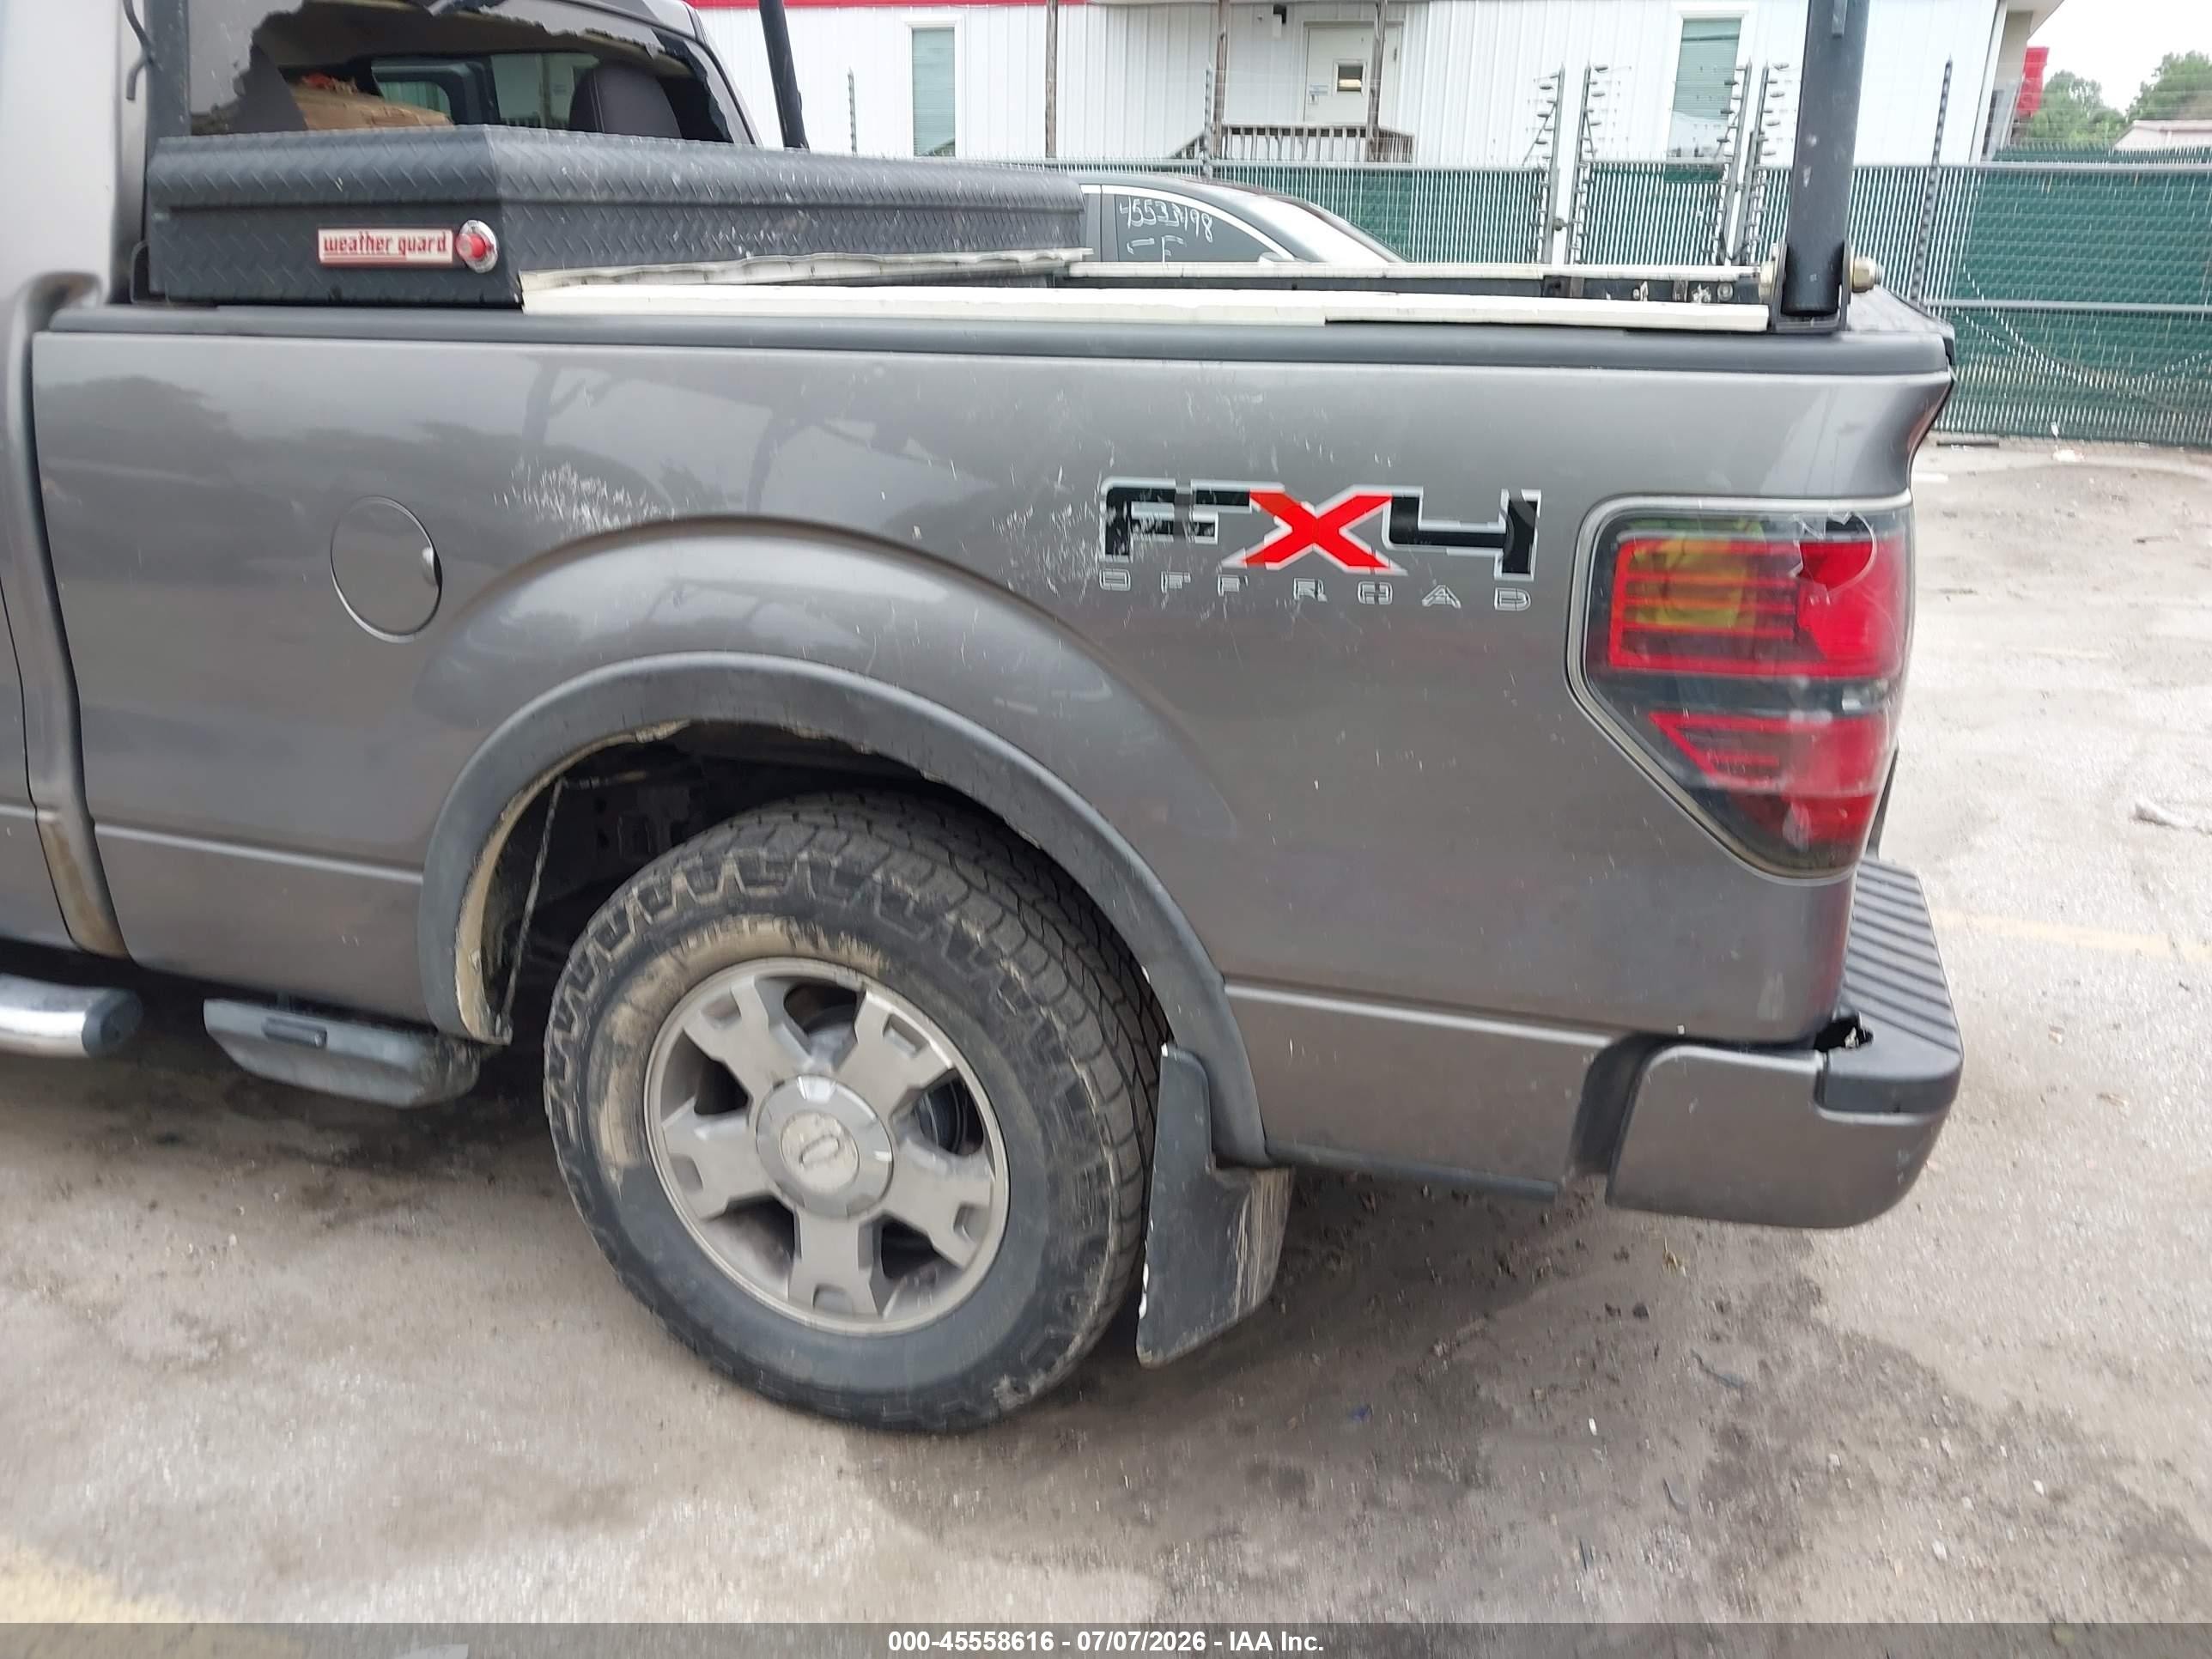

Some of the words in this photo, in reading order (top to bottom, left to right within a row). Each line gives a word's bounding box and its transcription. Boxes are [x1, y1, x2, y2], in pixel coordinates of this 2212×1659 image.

[323, 231, 392, 252] weather
[398, 231, 447, 256] guard
[1100, 477, 1541, 581] FX4
[1292, 577, 1532, 611] ROAD
